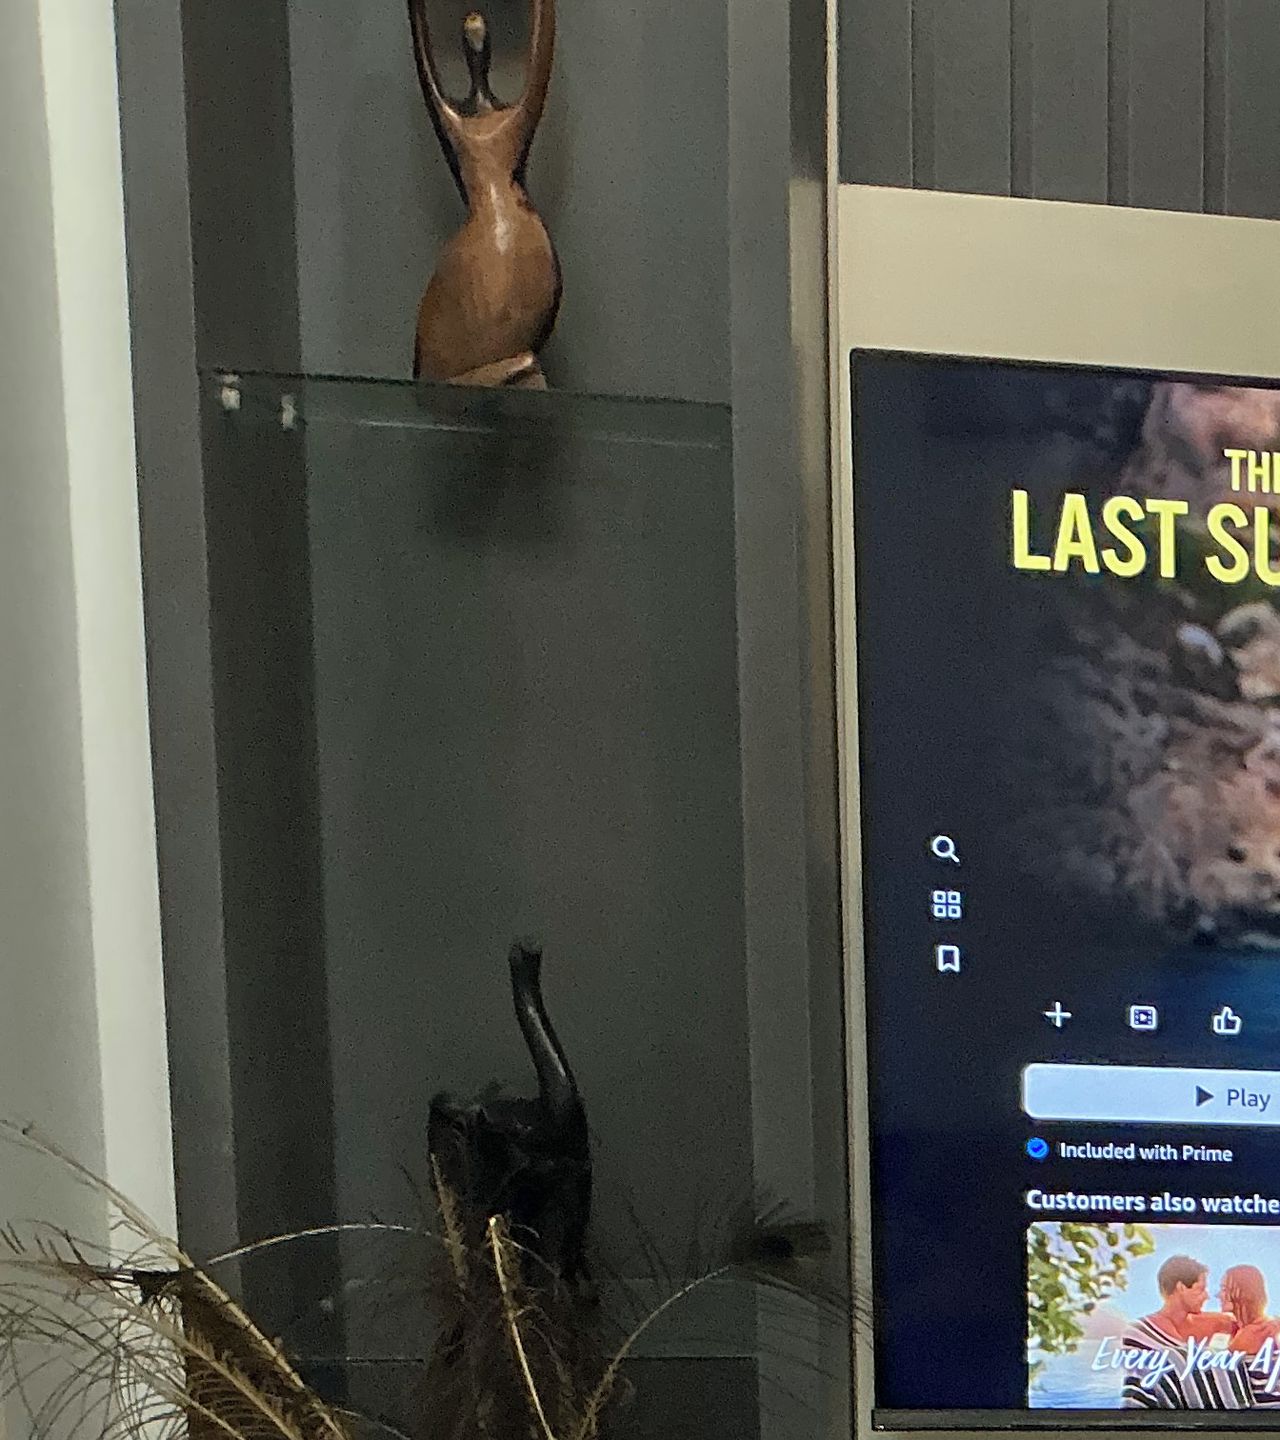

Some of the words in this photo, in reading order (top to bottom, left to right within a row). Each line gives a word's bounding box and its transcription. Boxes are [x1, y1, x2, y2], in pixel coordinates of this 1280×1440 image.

[1012, 489, 1189, 579] LAST
[1227, 1089, 1271, 1112] Play
[1060, 1142, 1135, 1160] Included
[1139, 1143, 1178, 1160] with
[1183, 1145, 1233, 1162] Prime
[1026, 1189, 1145, 1211] Customers
[1150, 1192, 1195, 1212] also
[1091, 1335, 1175, 1388] Every
[1179, 1335, 1245, 1381] Year
